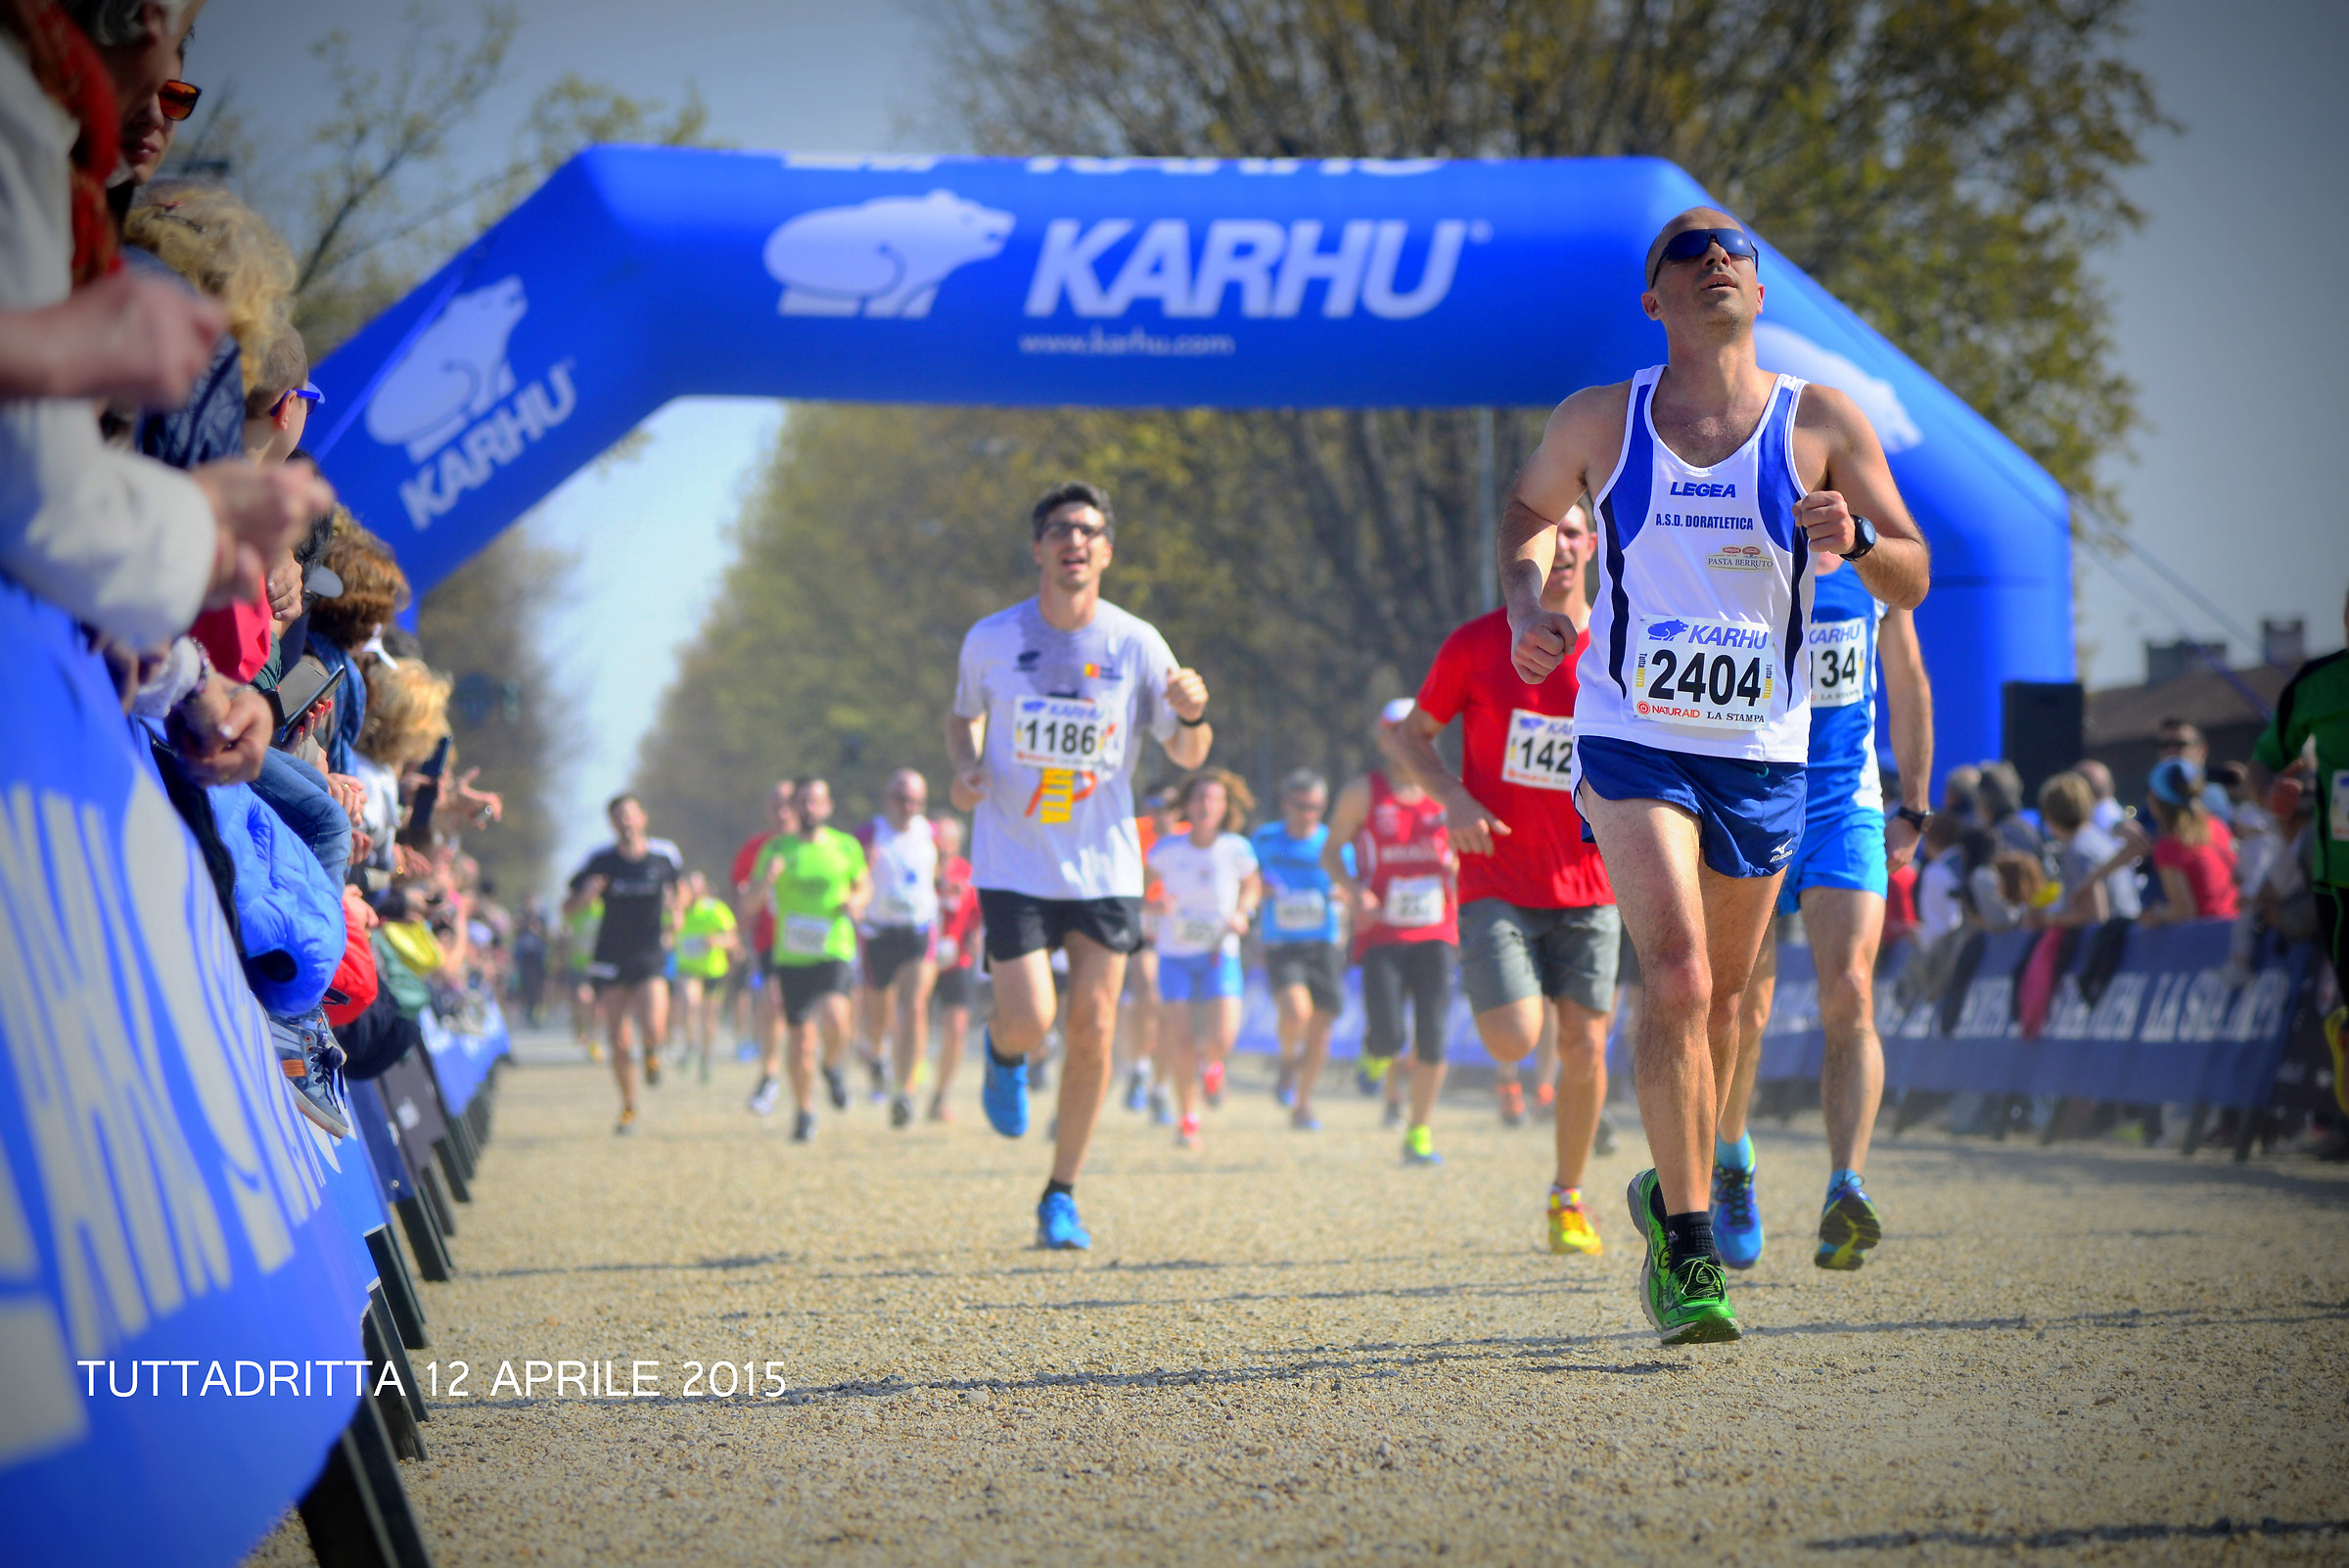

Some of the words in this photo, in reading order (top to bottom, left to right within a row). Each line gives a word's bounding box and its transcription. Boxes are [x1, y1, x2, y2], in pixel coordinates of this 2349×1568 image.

[1023, 218, 1468, 319] KARHU
[1018, 326, 1236, 355] www.karhu.com
[398, 363, 577, 531] KARHU
[1670, 482, 1736, 498] LEGEA
[1656, 513, 1683, 527] A.S.D.
[1685, 515, 1754, 530] DORATLETICA
[1735, 559, 1773, 570] BERRUTO
[1688, 624, 1769, 650] KARHU
[1648, 649, 1762, 707] 2404
[1652, 705, 1701, 718] NATURAID
[1706, 711, 1723, 720] LA
[1727, 713, 1765, 723] STAMPA
[1025, 718, 1096, 756] 1186
